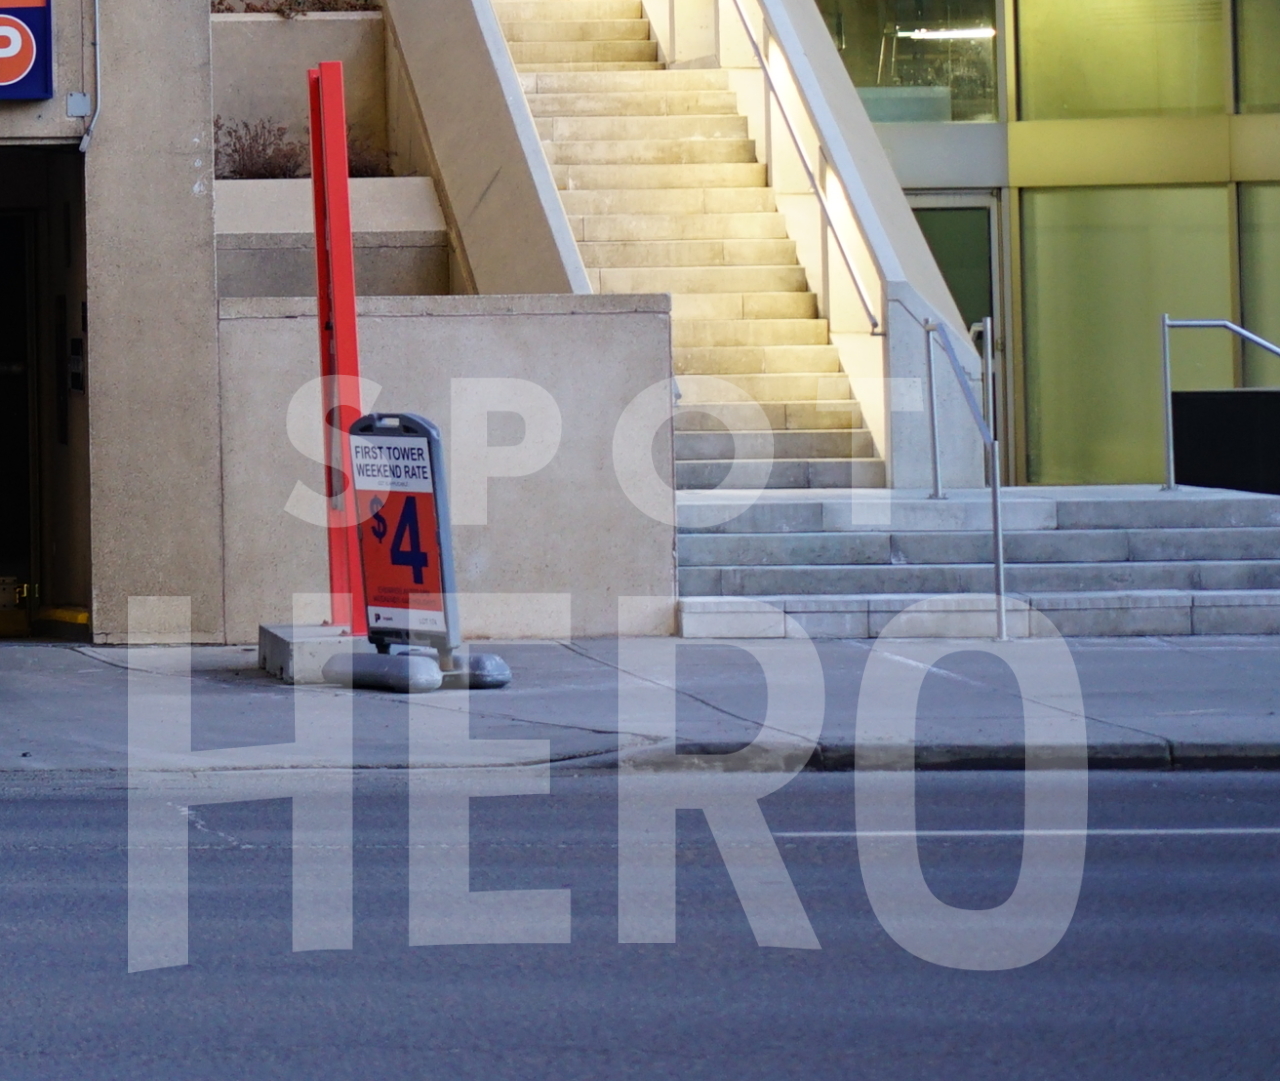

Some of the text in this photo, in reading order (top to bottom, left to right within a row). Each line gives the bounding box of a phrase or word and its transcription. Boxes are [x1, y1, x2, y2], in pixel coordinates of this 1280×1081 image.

[355, 445, 425, 461] FIRST TOWER
[356, 463, 429, 480] WEEKEND RATE
[370, 494, 428, 585] $4
